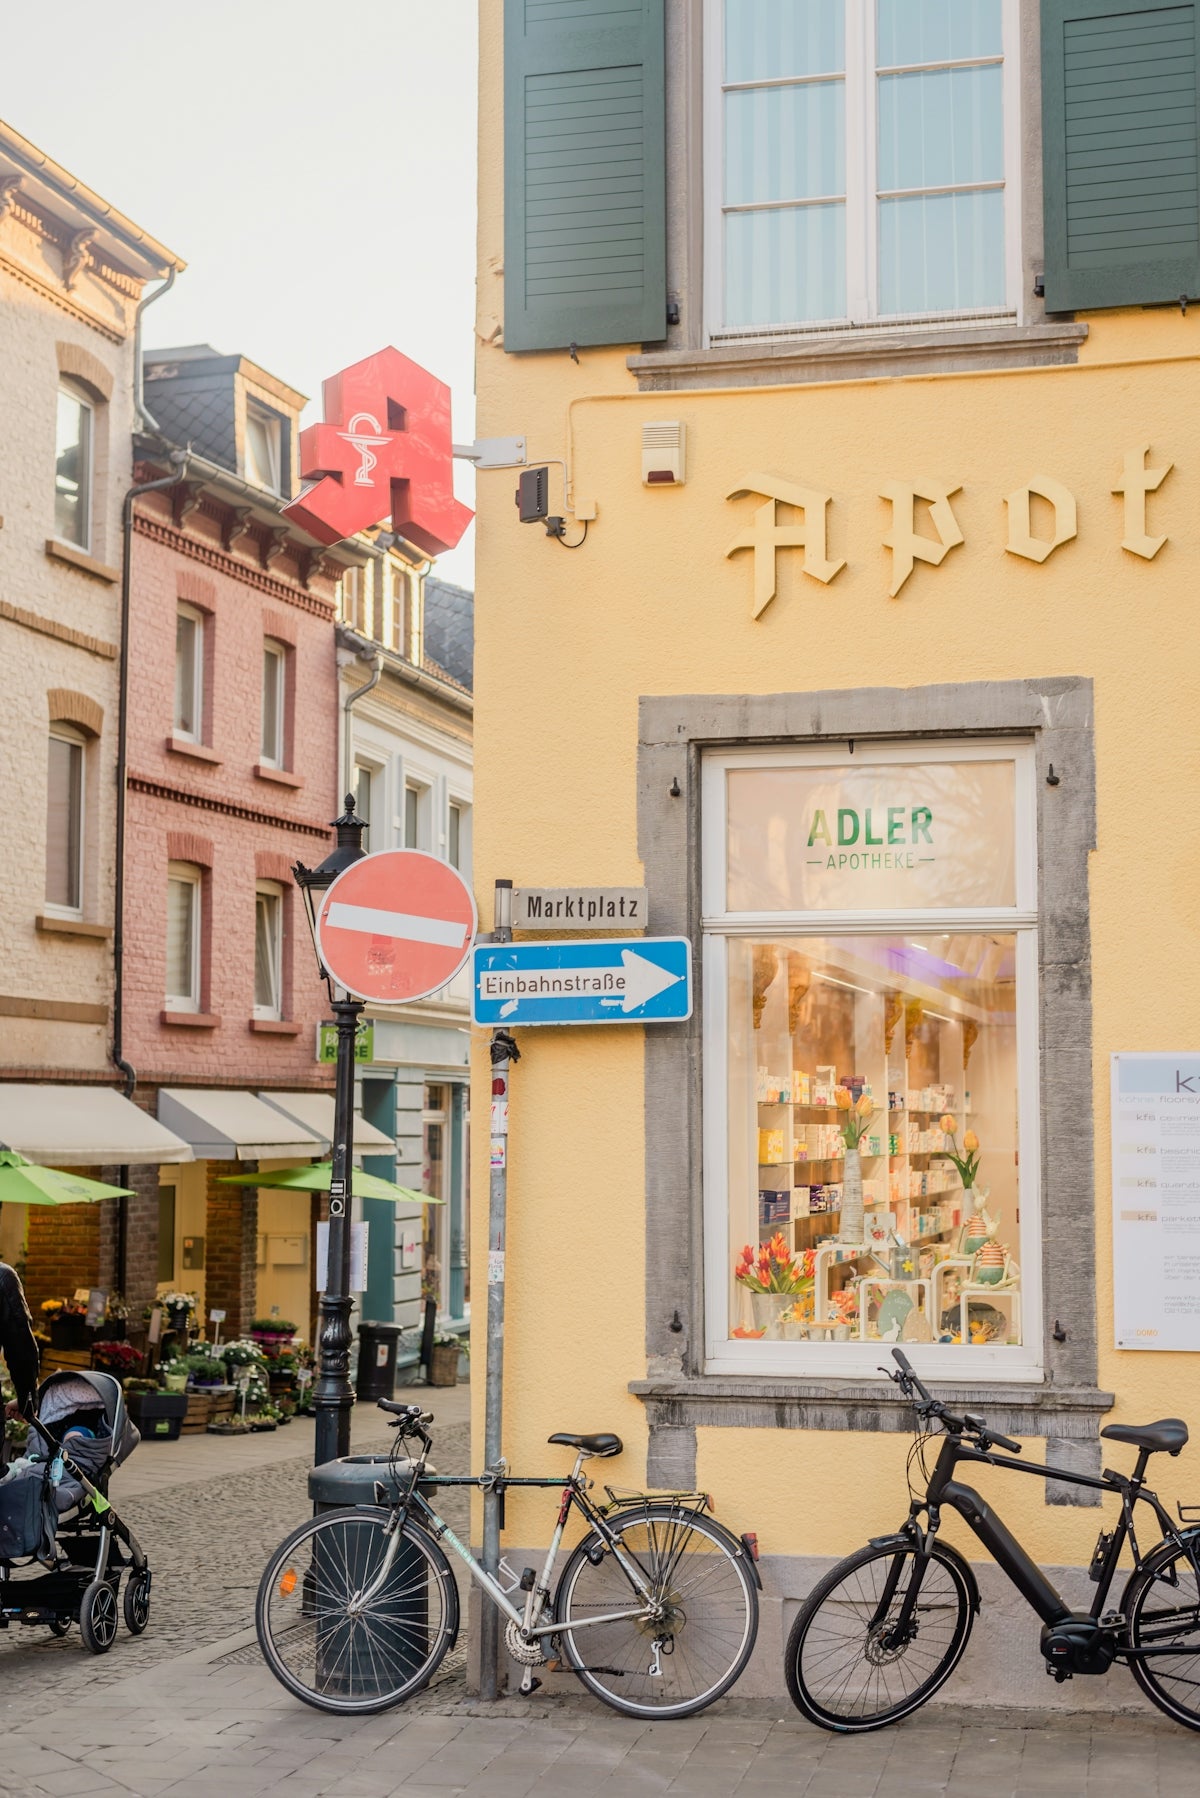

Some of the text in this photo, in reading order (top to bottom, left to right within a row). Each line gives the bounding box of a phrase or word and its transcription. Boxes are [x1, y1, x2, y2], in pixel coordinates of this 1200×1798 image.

[724, 444, 1175, 622] Apot
[807, 806, 934, 847] ADLER
[826, 852, 914, 870] APOTHEKE
[527, 895, 638, 922] Marktplatz
[485, 973, 626, 995] Einbahnstraße
